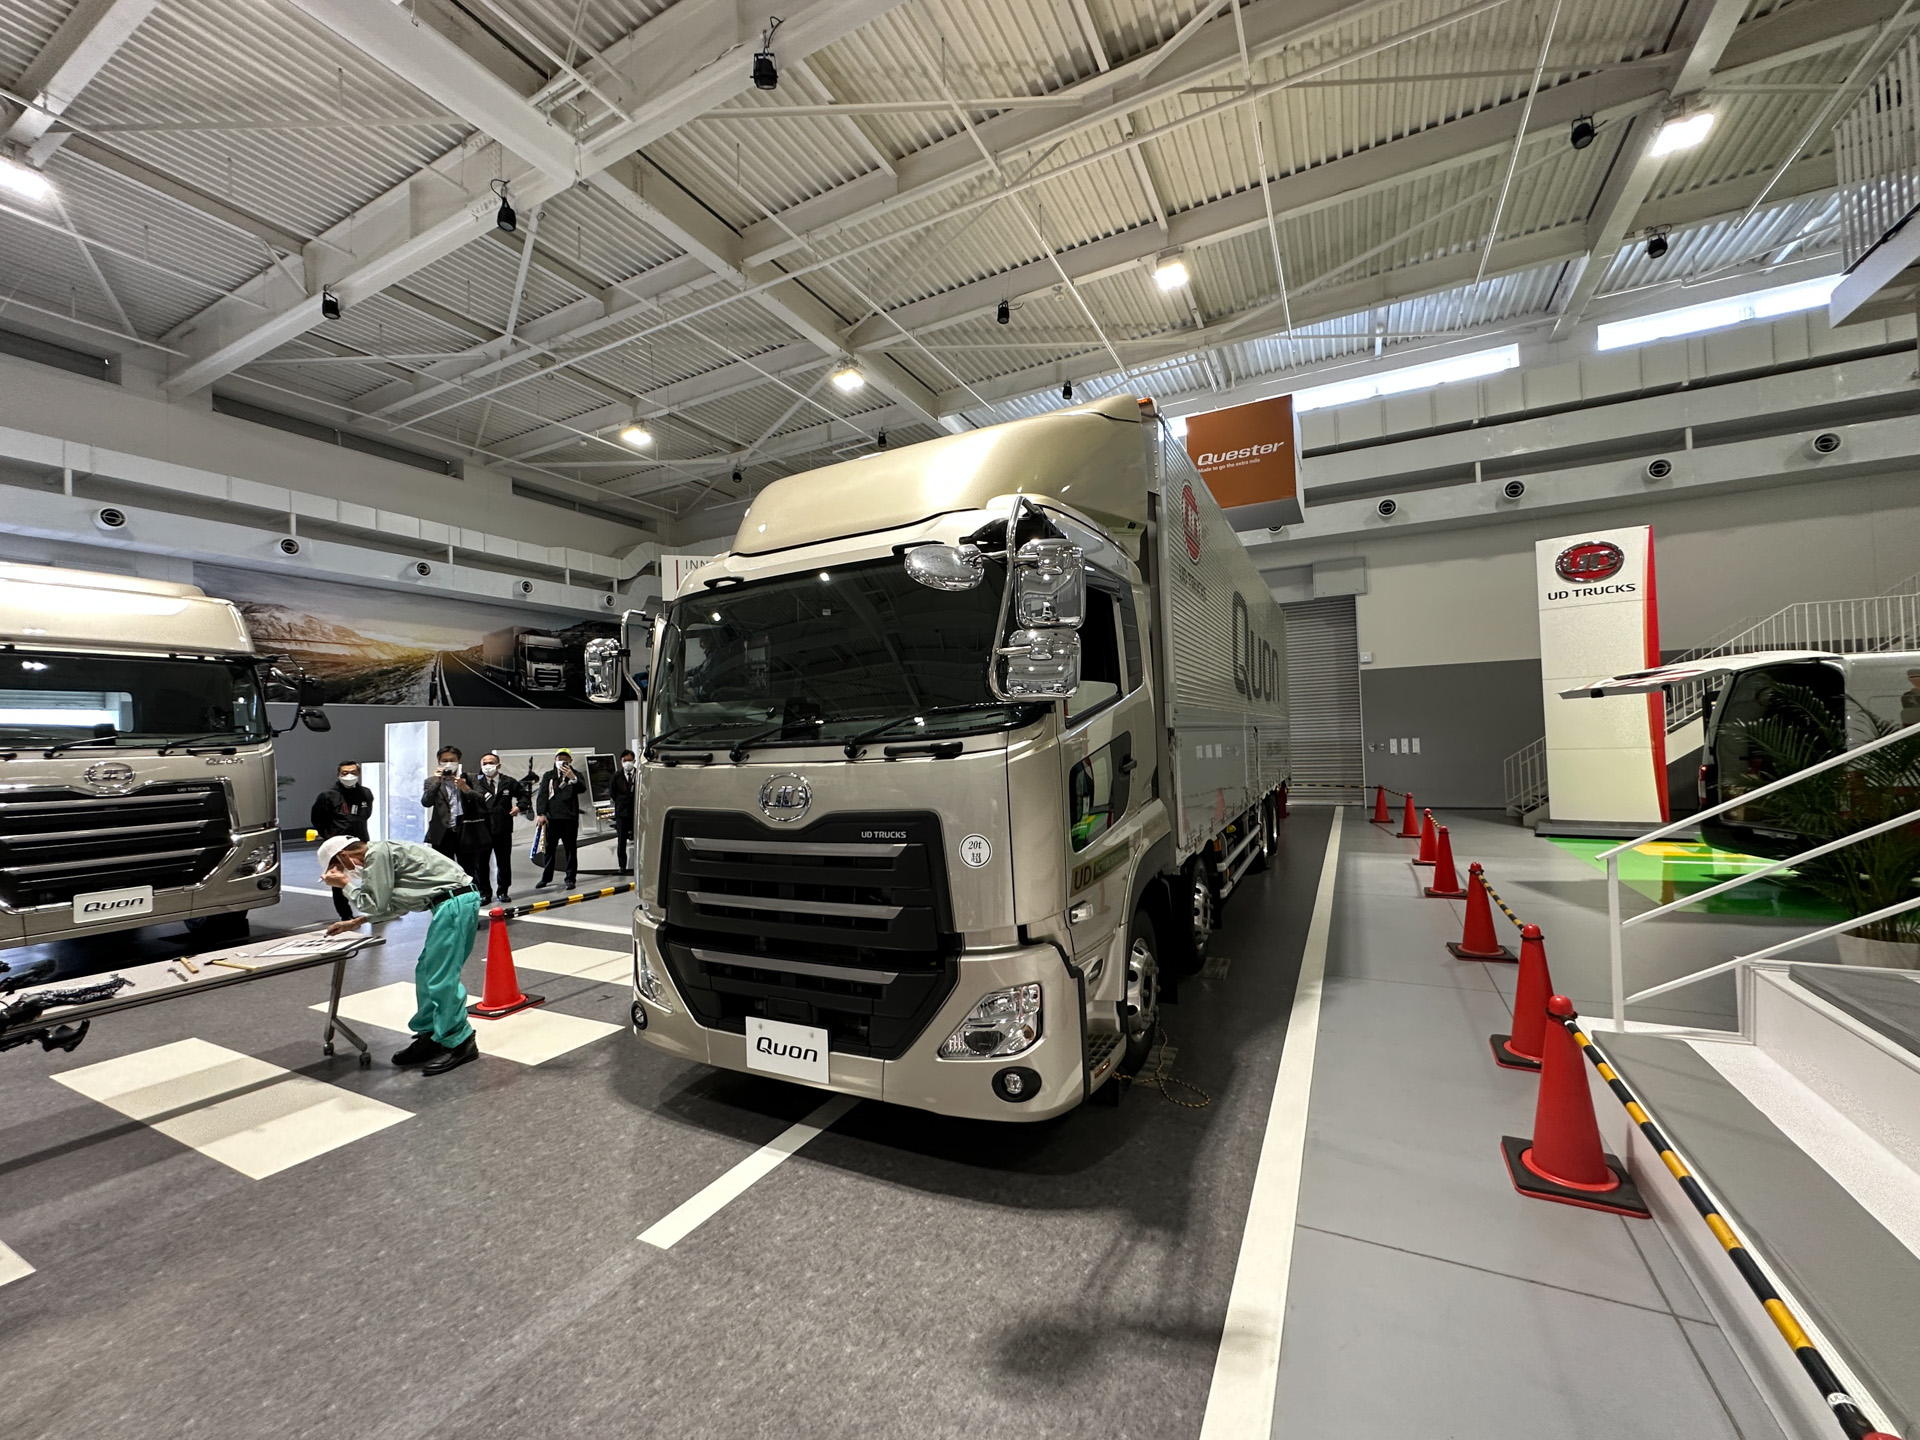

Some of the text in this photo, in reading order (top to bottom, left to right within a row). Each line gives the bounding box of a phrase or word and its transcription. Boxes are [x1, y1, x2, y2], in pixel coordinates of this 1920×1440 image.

[1197, 441, 1284, 466] Quester
[1547, 583, 1636, 601] UD TRUCKS
[1232, 590, 1280, 702] Quon
[861, 831, 907, 839] UD TRUCKS
[968, 840, 982, 850] 20t
[1074, 865, 1092, 890] UD
[84, 897, 144, 912] Quon
[756, 1036, 818, 1062] Quon
